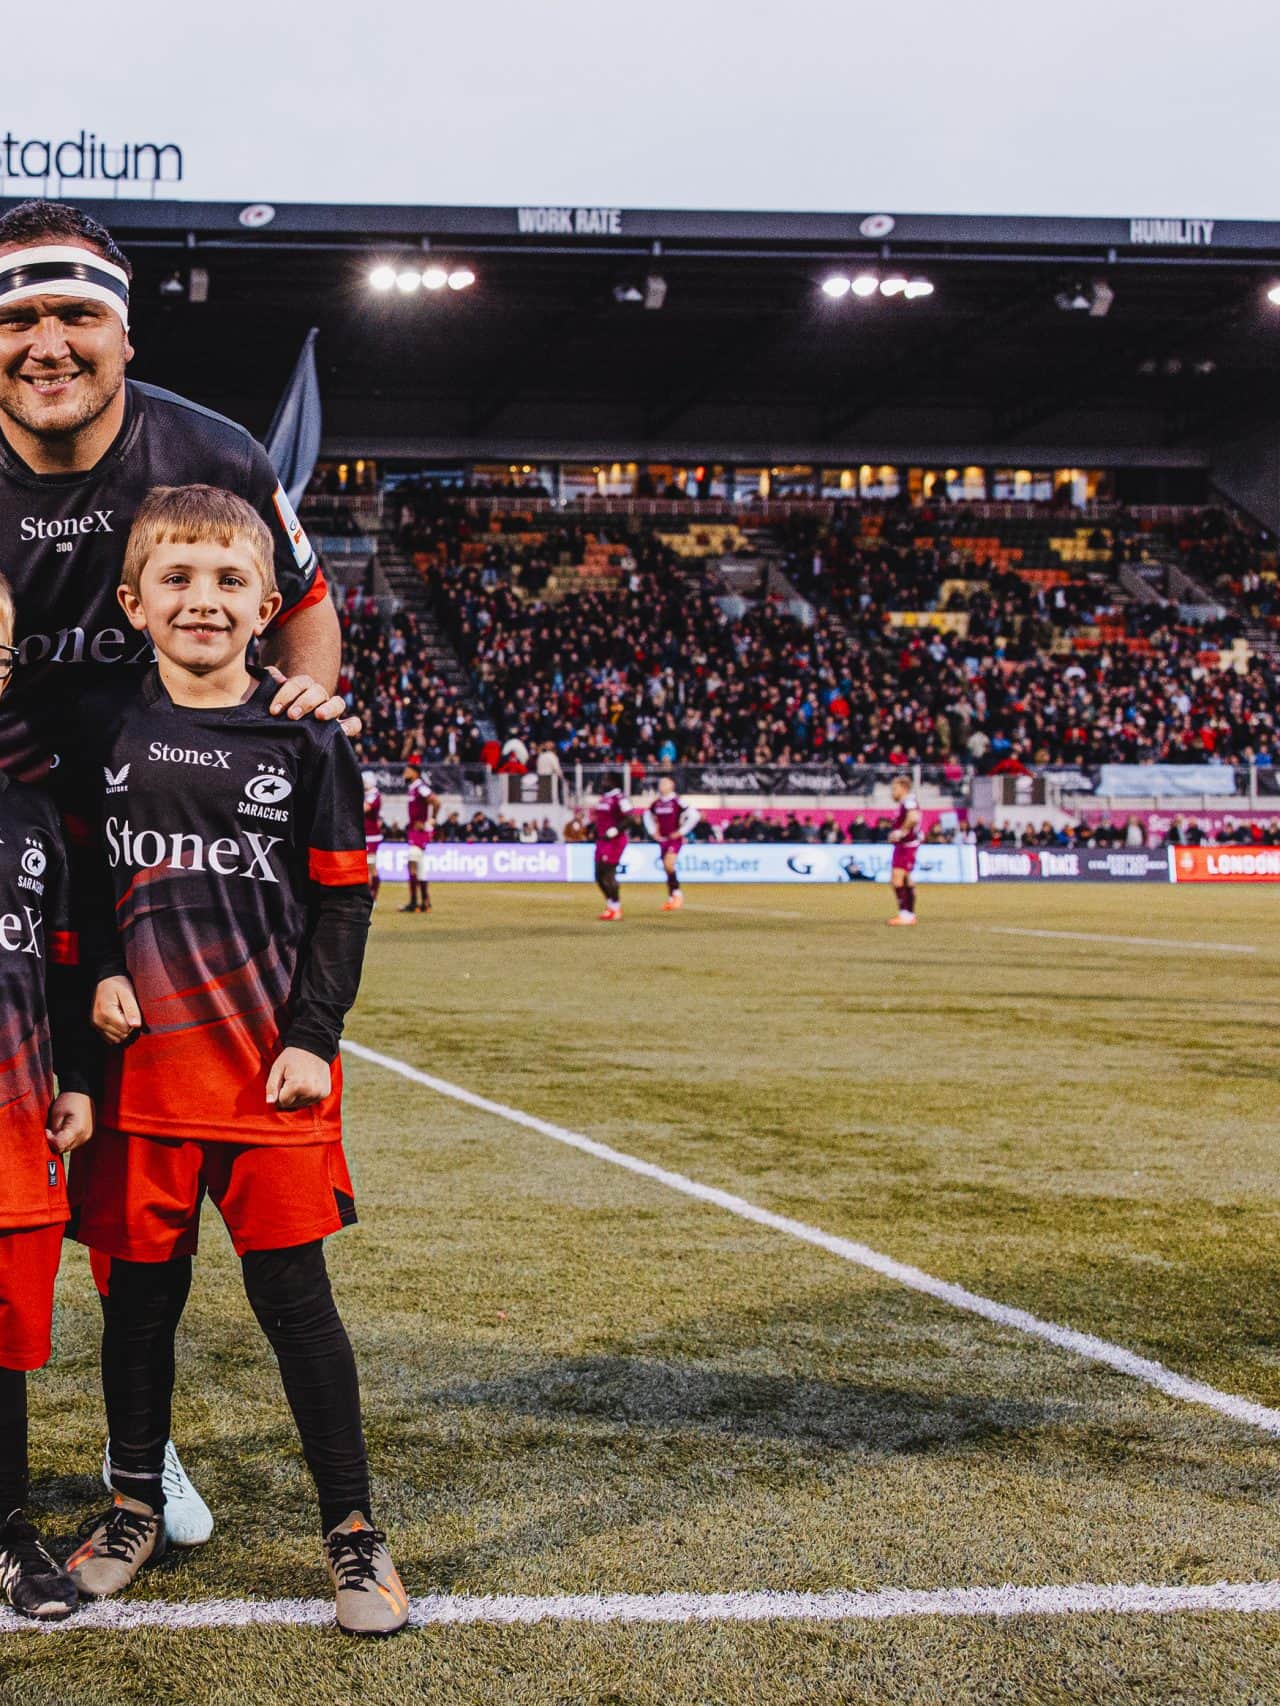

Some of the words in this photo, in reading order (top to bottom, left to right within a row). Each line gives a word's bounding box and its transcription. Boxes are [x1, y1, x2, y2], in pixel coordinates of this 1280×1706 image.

[518, 208, 573, 234] WORK
[576, 208, 622, 235] RATE
[1130, 219, 1215, 245] HUMILITY
[20, 510, 114, 541] StoneX
[18, 627, 158, 664] oneX
[148, 742, 233, 769] StoneX
[237, 801, 289, 823] SARACENS
[106, 816, 284, 883] StoneX
[395, 849, 488, 877] Fnding
[493, 850, 560, 872] Circle
